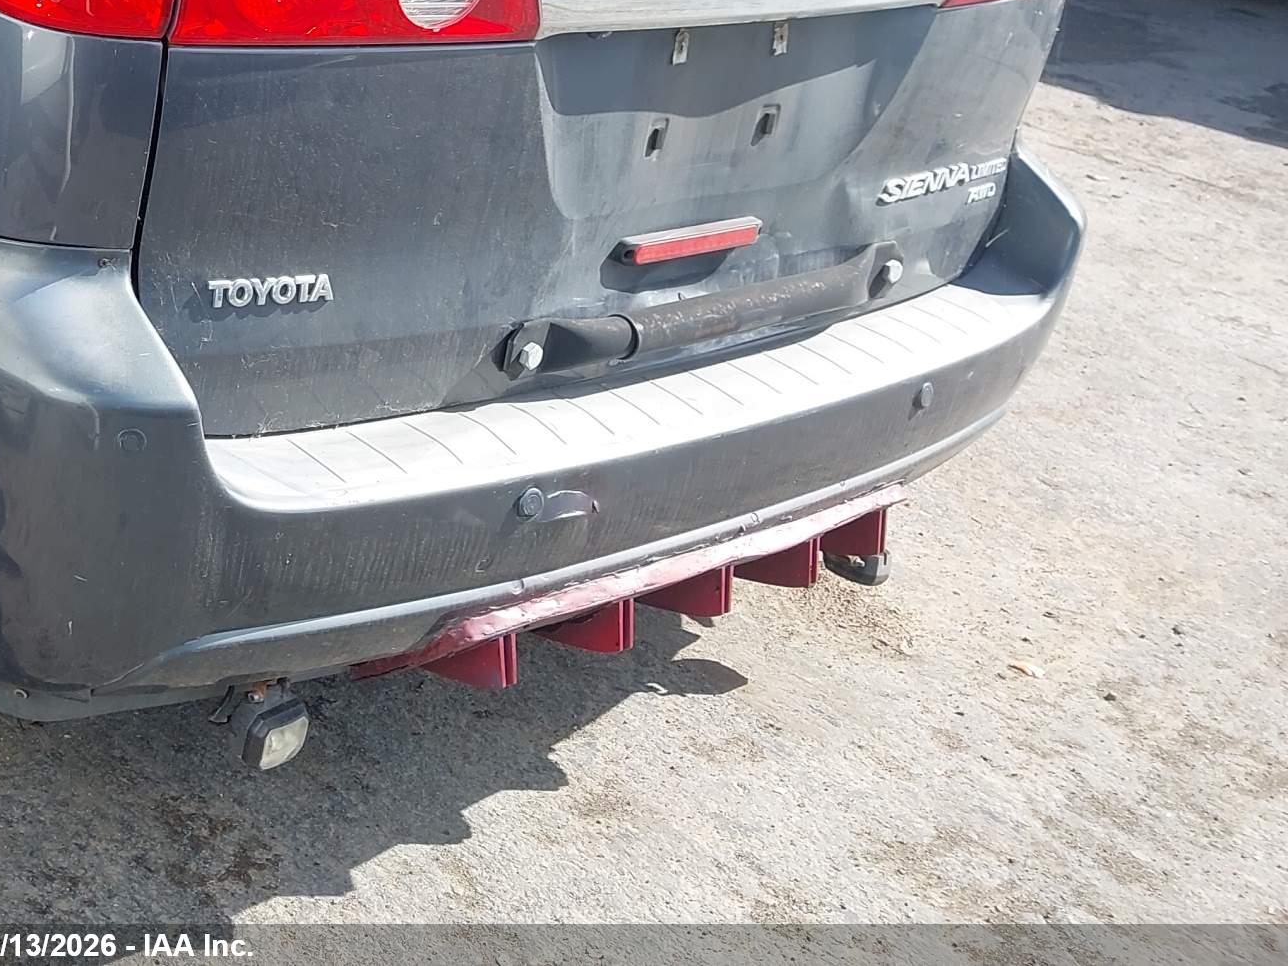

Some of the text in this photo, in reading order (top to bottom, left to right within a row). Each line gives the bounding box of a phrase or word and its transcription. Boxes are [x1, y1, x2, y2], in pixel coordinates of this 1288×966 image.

[878, 162, 970, 203] SIENNA
[967, 182, 996, 203] AWD
[208, 273, 334, 308] TOYOTA
